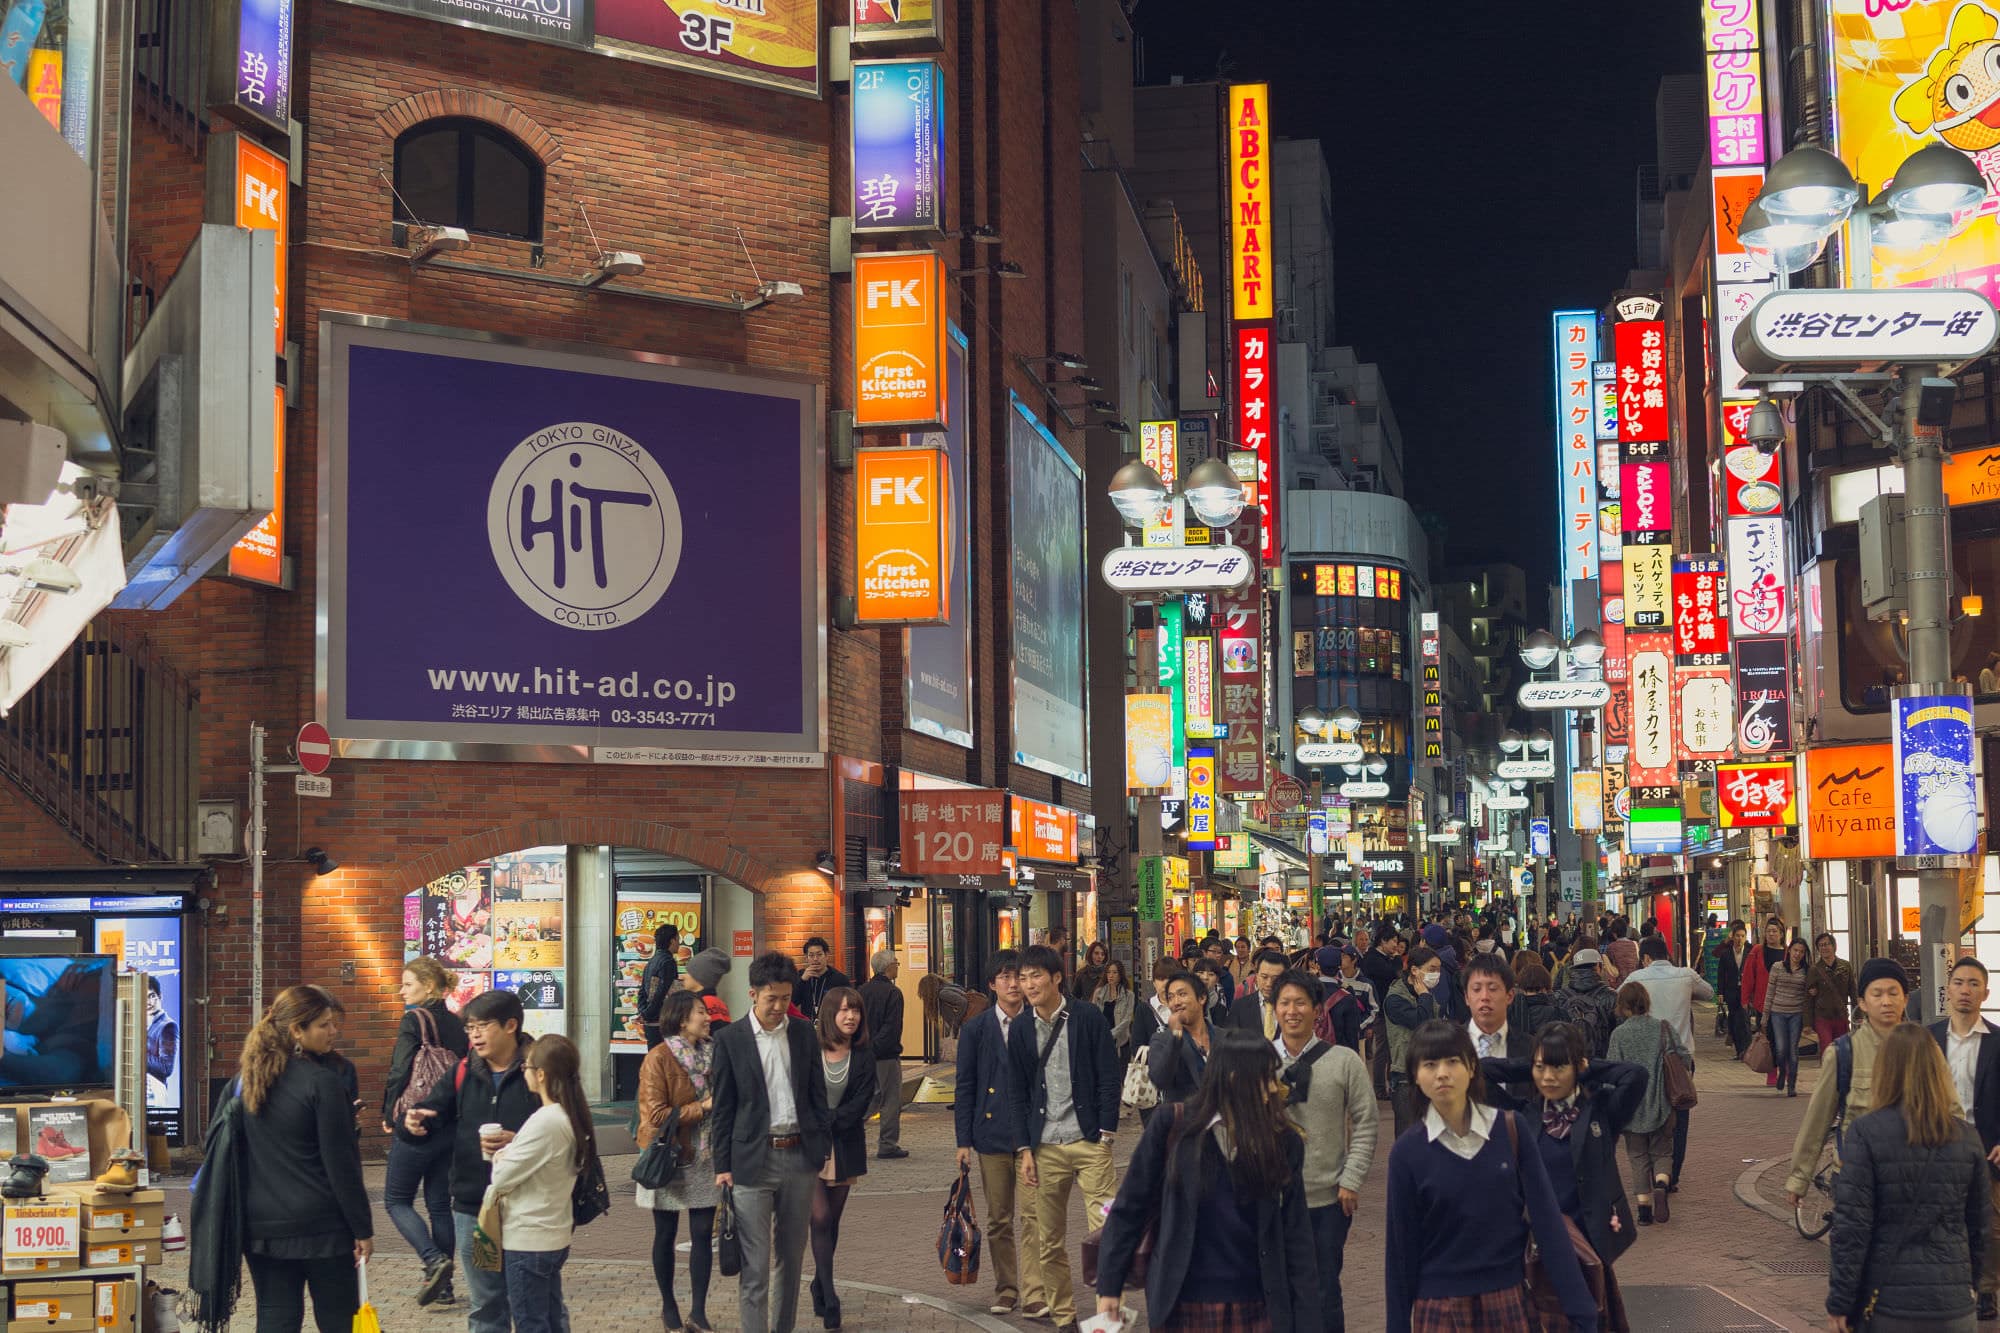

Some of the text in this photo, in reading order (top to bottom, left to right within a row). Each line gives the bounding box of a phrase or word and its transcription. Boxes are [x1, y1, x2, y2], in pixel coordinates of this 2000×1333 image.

[495, 7, 528, 21] AQUA
[533, 14, 571, 30] TOKYO
[680, 11, 732, 53] 3F
[858, 71, 884, 90] 2F
[1717, 138, 1757, 162] 3F
[244, 174, 279, 222] FK
[860, 173, 899, 223] 碧
[1238, 98, 1261, 305] ABC-MART
[1733, 261, 1752, 273] 2F
[867, 279, 921, 308] FK
[1766, 311, 1984, 337] 渋谷センター街
[874, 366, 914, 378] First
[1641, 330, 1664, 408] お好み焼
[862, 378, 927, 391] Kitchen
[1245, 338, 1266, 449] カラオケ
[1621, 365, 1643, 436] もんじゃ
[526, 426, 641, 462] TOKYO GINZA
[1569, 326, 1593, 579] カラオケ&パーティー
[870, 476, 925, 506] FK
[1637, 533, 1654, 544] 4F
[878, 564, 917, 576] First
[1111, 558, 1241, 576] 渋谷センター街
[865, 577, 930, 590] Kitchen
[554, 607, 621, 627] CO.,LTD.
[1638, 613, 1660, 624] B1F
[1696, 575, 1716, 641] お好み焼
[1678, 593, 1696, 651] もんじゃ
[427, 667, 736, 707] www.hit-ad.co.jp
[1524, 688, 1606, 699] 渋谷センター街
[452, 703, 716, 726] 渋谷エリア 掲出広告募集中 03-3543-7771
[1214, 724, 1228, 737] 2F
[1224, 684, 1260, 782] 歌広場
[1727, 770, 1786, 810] すき家
[1828, 788, 1872, 807] Cafe
[902, 801, 1003, 823] 1階・地下1階
[1162, 802, 1180, 812] 1F
[1191, 793, 1210, 832] 松屋
[1813, 814, 1896, 837] Miyama
[914, 832, 1000, 862] 120 席
[1334, 860, 1404, 871] Mconald's
[14, 902, 41, 910] KENT
[126, 941, 176, 958] ENT
[15, 1226, 65, 1248] 18,900
